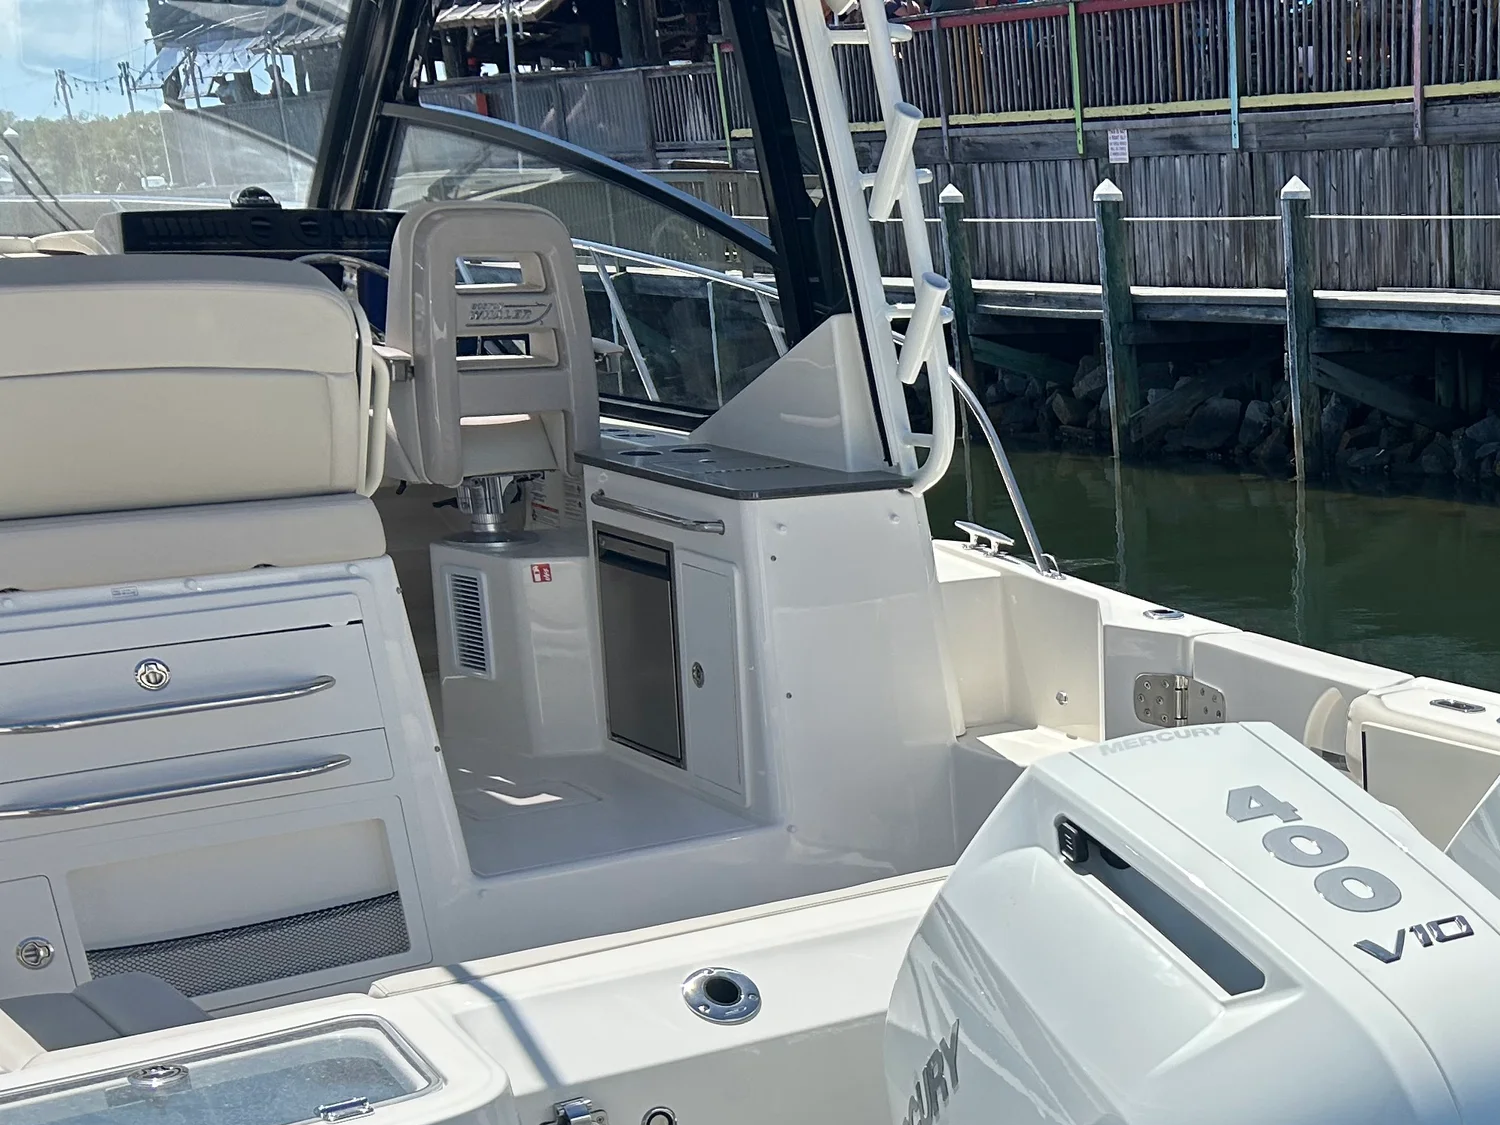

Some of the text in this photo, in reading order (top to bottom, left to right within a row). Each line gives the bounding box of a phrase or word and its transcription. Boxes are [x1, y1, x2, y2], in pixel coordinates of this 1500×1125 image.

[470, 309, 532, 321] WHALER
[1099, 726, 1222, 757] MERCURY
[1226, 785, 1402, 913] 400
[1353, 914, 1475, 965] V10
